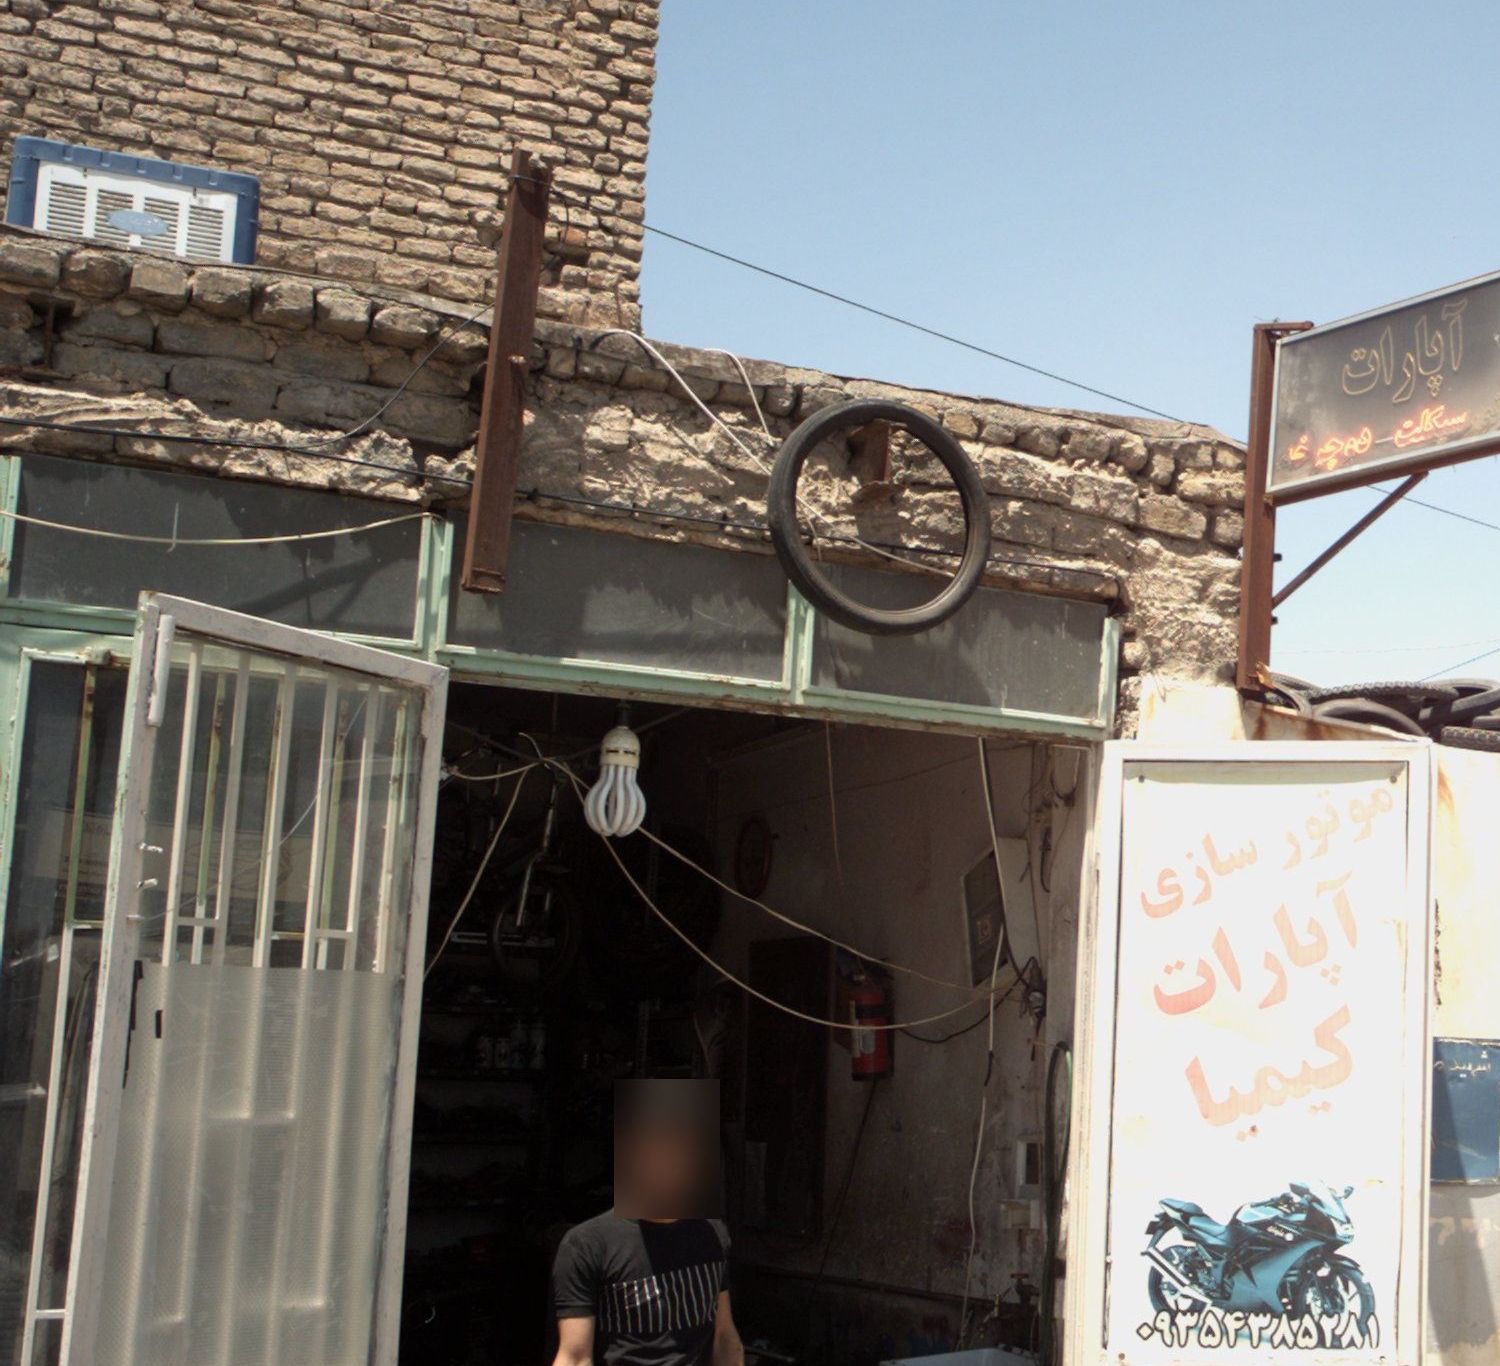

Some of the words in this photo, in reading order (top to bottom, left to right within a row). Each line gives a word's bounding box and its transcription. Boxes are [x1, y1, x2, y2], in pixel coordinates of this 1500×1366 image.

[1343, 300, 1468, 403] آپارات
[1284, 787, 1394, 870] موتور
[1140, 833, 1258, 919] سازی
[1153, 871, 1358, 1015] آپارات
[1185, 1005, 1353, 1141] کیمیا
[1136, 1309, 1380, 1350] ۰۹۳۵۴۳۸۵۲۸۱
